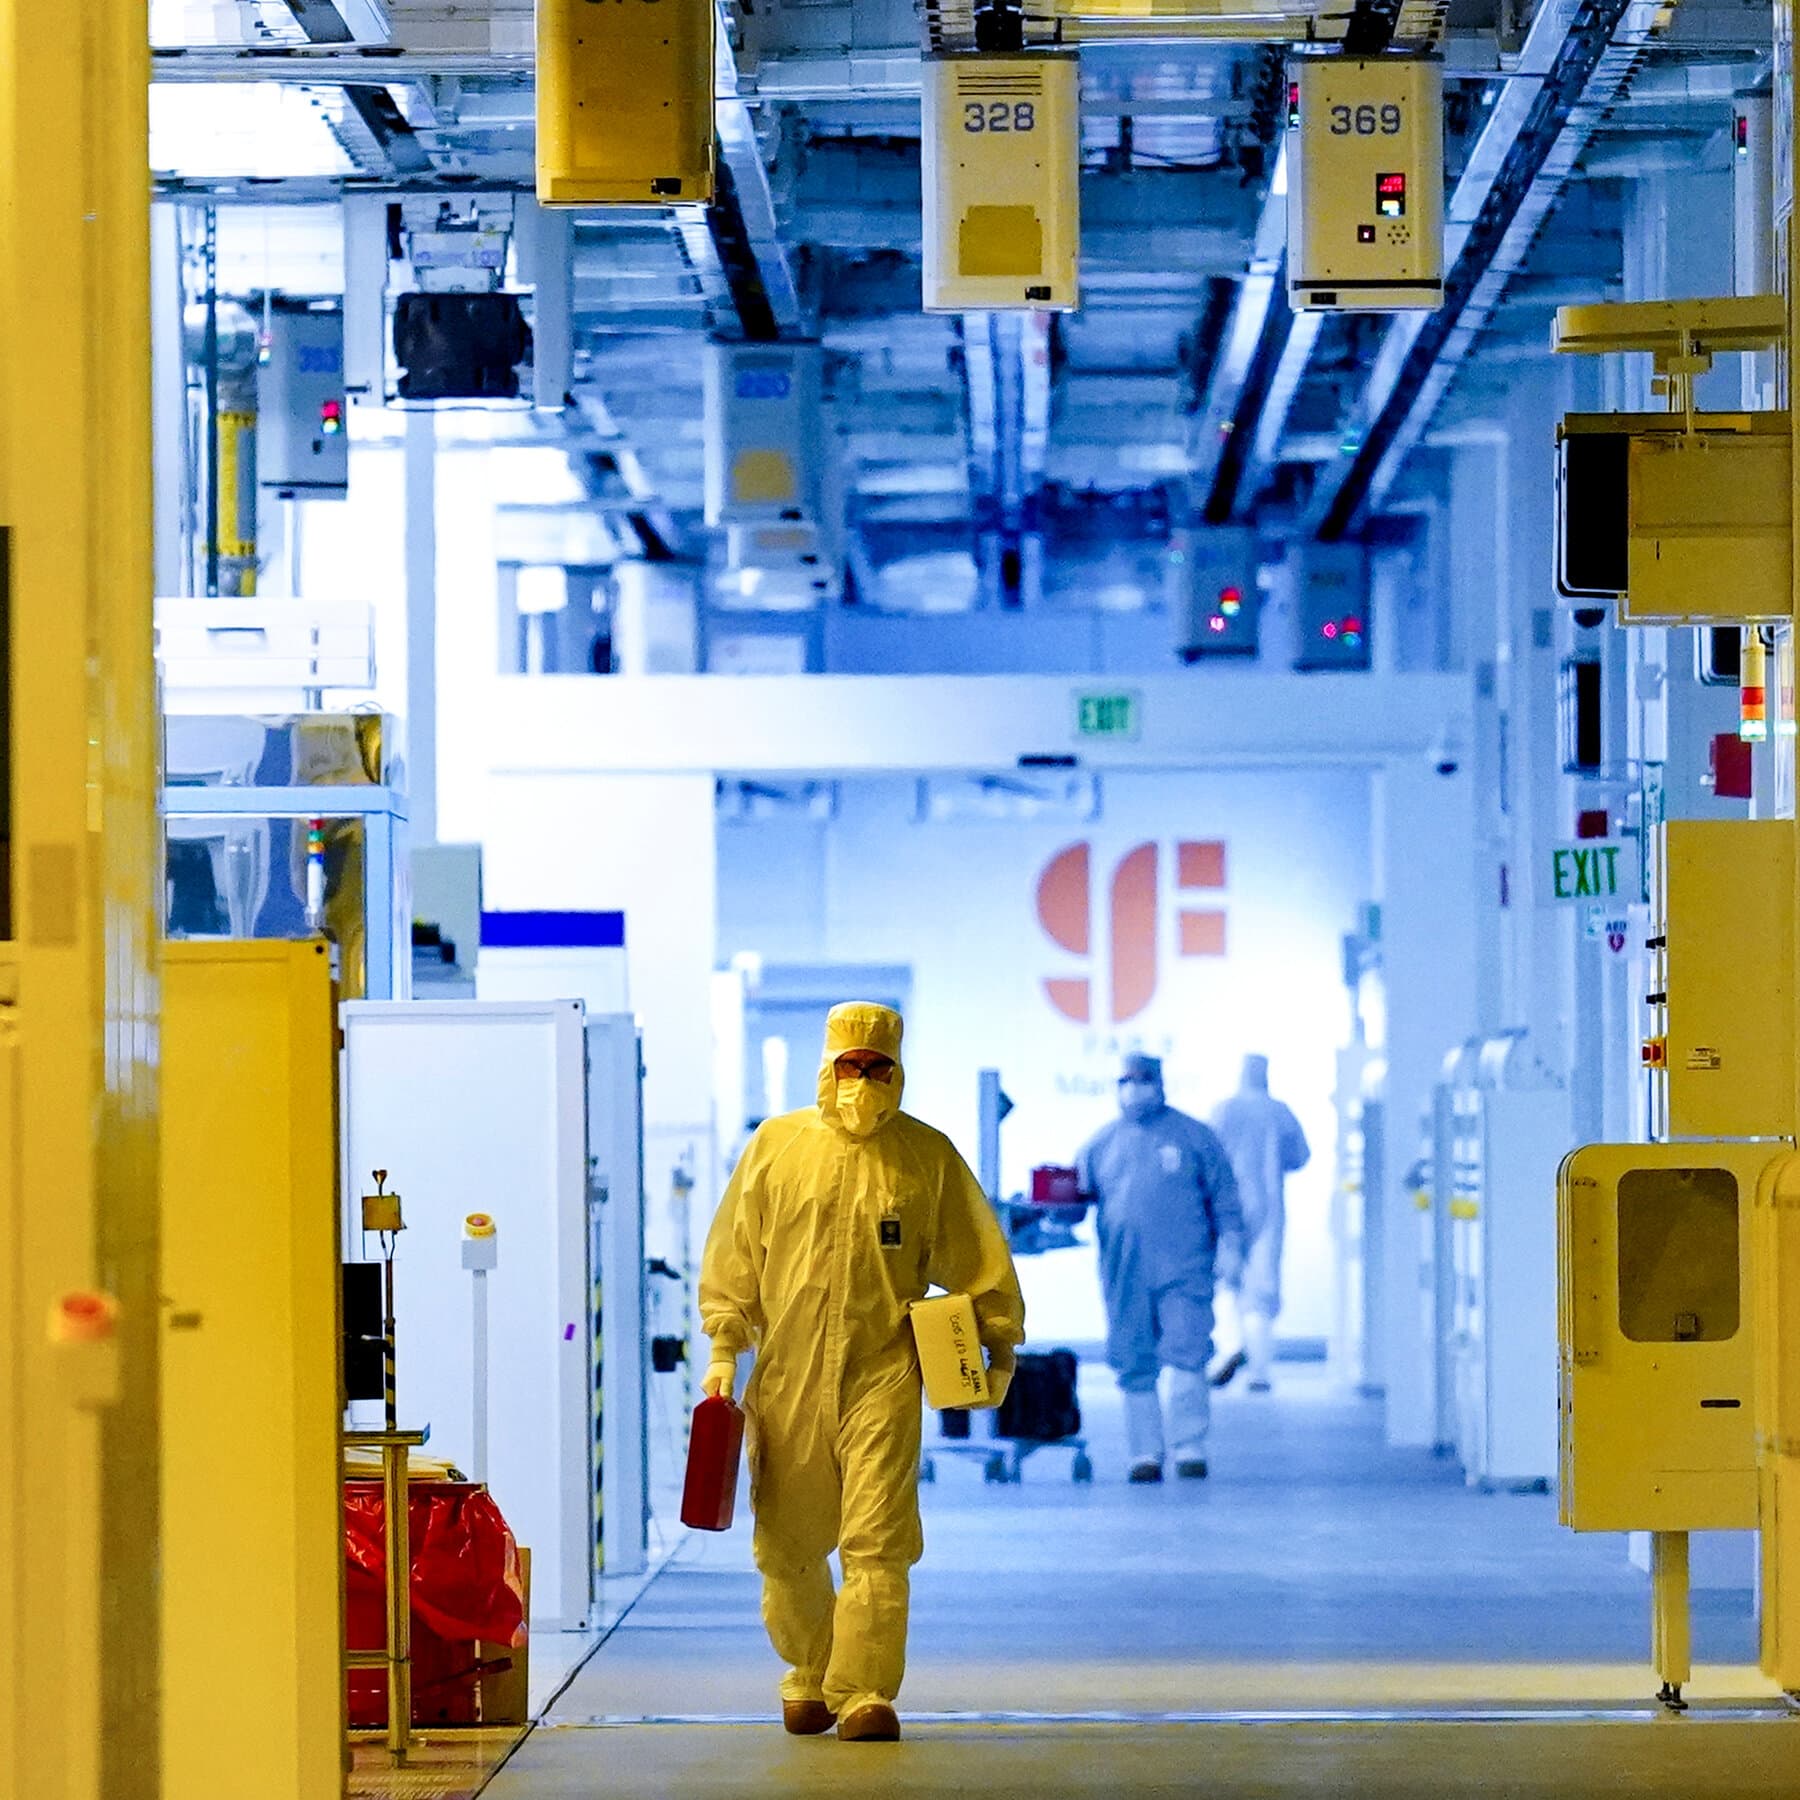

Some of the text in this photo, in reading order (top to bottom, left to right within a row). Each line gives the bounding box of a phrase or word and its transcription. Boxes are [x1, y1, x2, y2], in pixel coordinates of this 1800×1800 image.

[964, 102, 1034, 132] 328
[1330, 104, 1401, 135] 369
[1080, 696, 1129, 731] EXIT
[1553, 846, 1620, 898] EXIT
